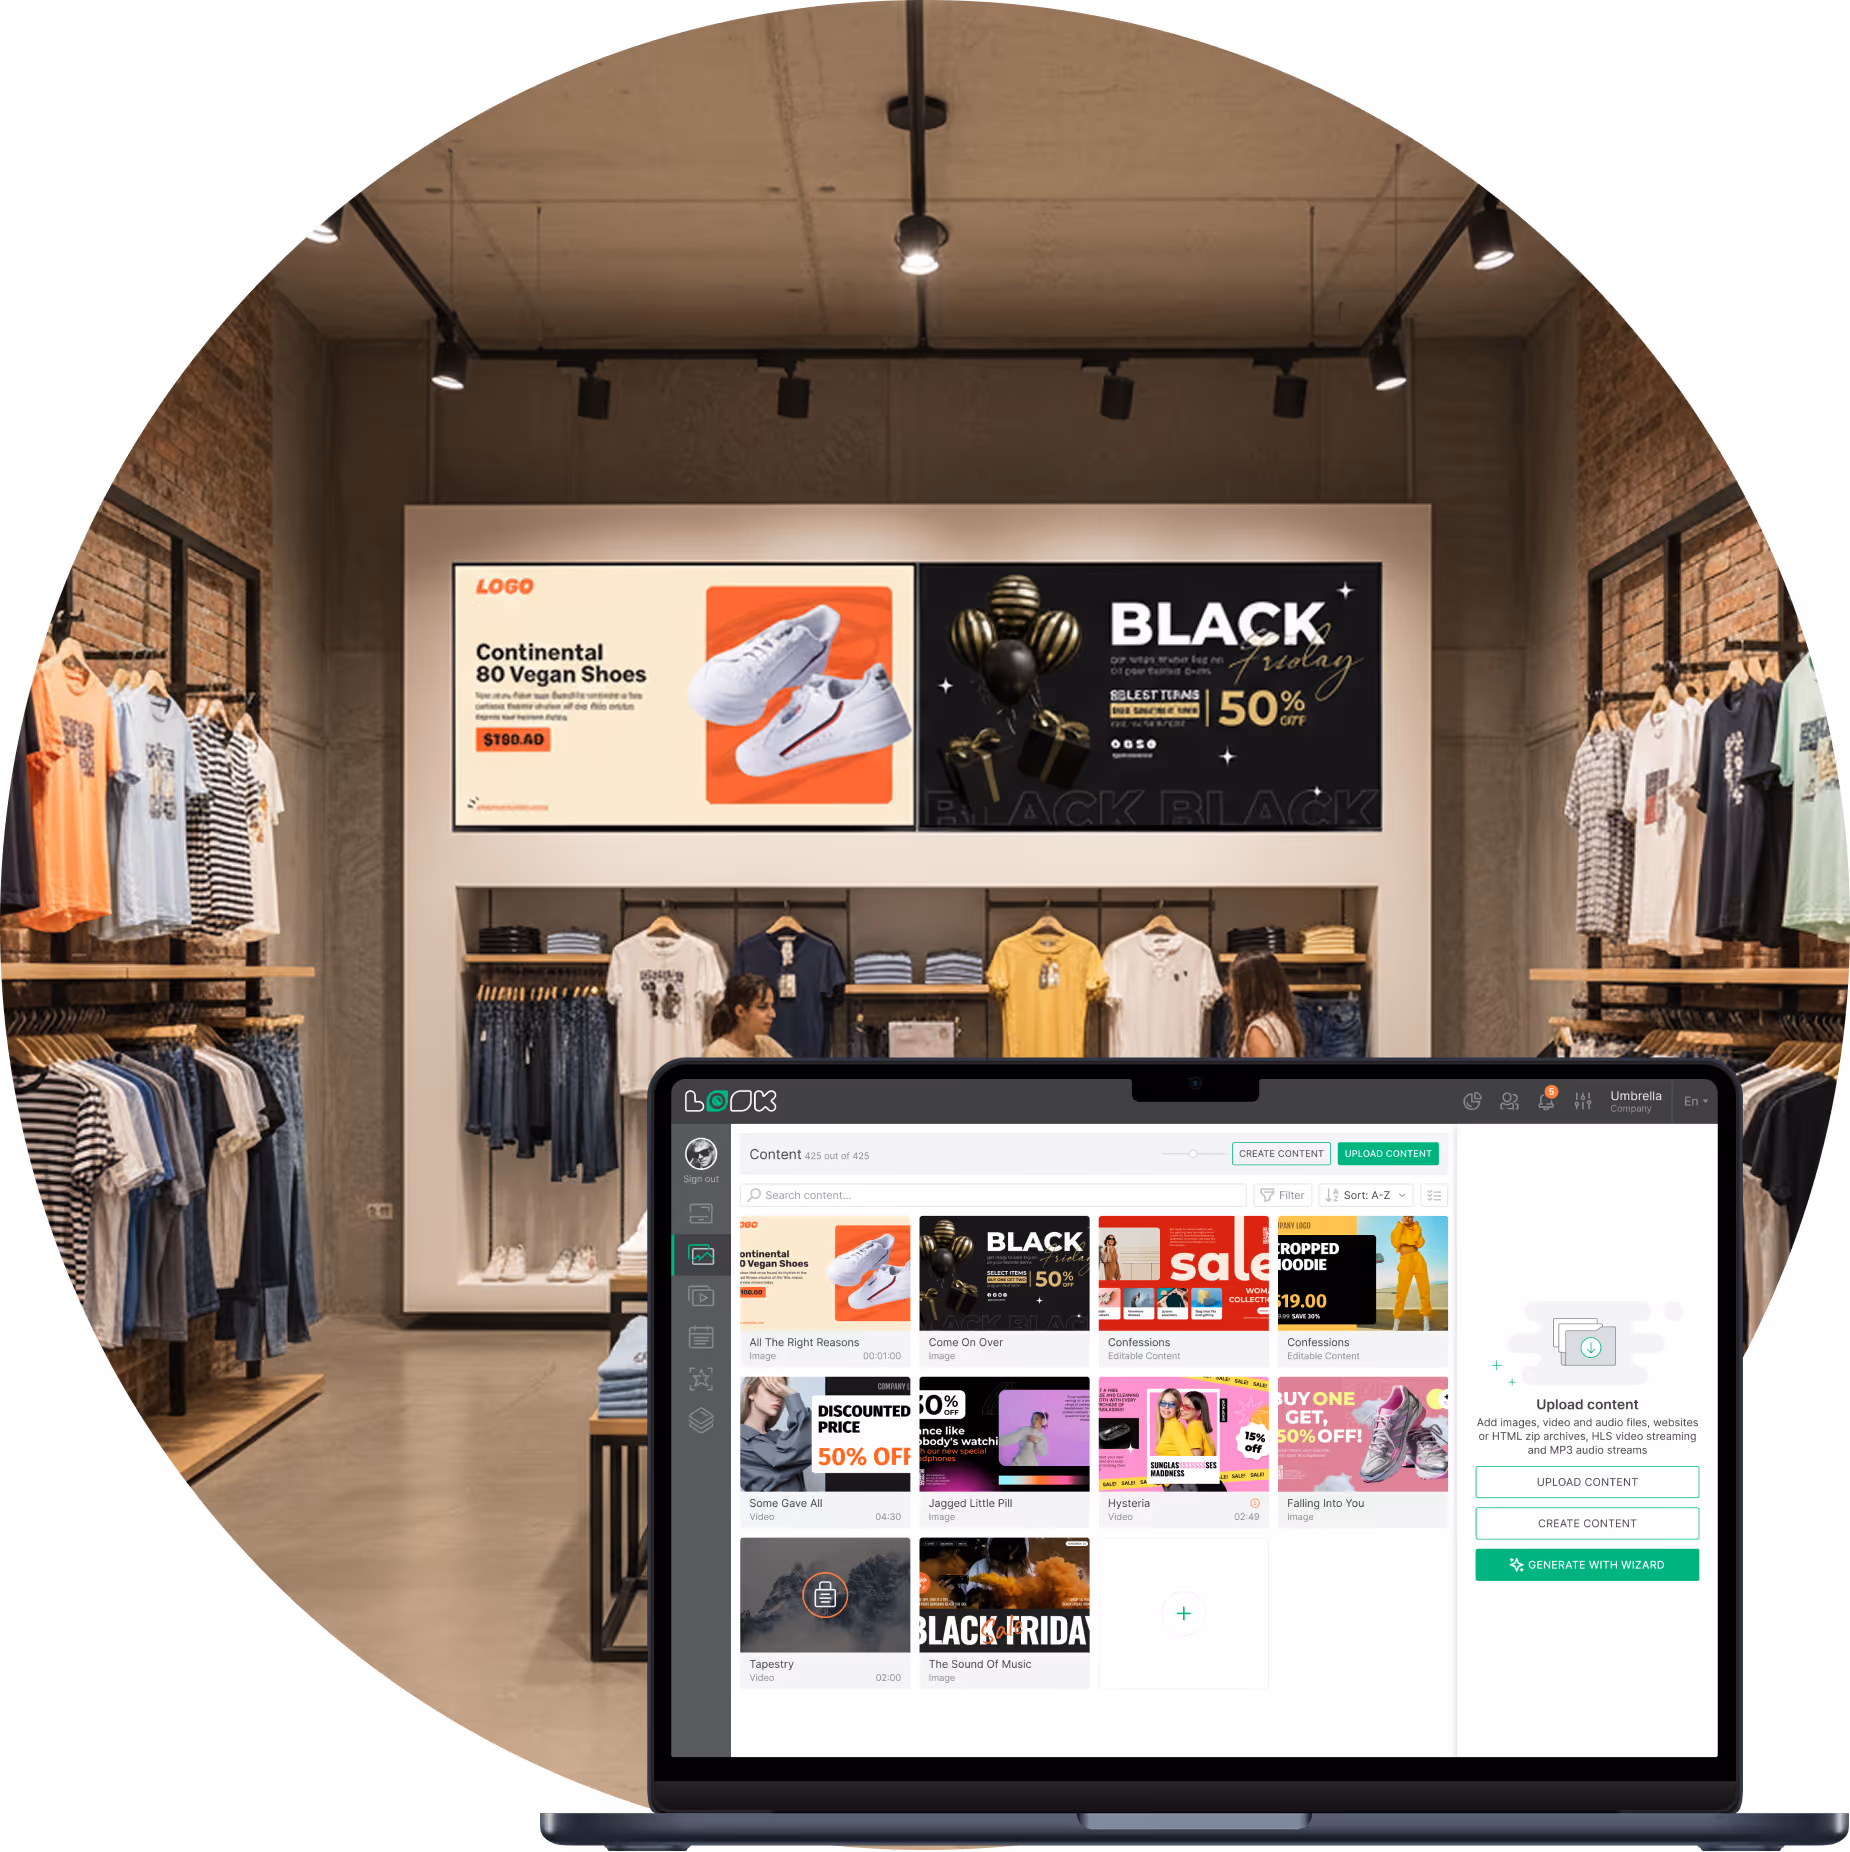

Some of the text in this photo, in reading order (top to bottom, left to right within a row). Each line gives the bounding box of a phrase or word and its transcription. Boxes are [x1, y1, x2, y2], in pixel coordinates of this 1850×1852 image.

[476, 577, 535, 595] LOGO
[1111, 601, 1326, 646] BLACK
[476, 643, 603, 661] Continental
[476, 665, 647, 688] 80 Vegan Shoes
[1548, 1087, 1556, 1096] 5
[1610, 1090, 1662, 1101] Umbrella
[1684, 1096, 1699, 1106] En
[1610, 1104, 1652, 1114] Company
[750, 1149, 870, 1160] Content 425 out of 425
[1239, 1149, 1324, 1158] CREATE CONTENT
[1344, 1149, 1432, 1158] UPLOAD CONTENT
[683, 1174, 720, 1185] Sign out
[765, 1190, 852, 1200] Search content...
[1279, 1189, 1305, 1200] Filter
[1344, 1190, 1390, 1200] Sort: A-Z
[987, 1231, 1084, 1252] BLACK
[748, 1260, 777, 1270] Vegan
[750, 1338, 859, 1349] All The Right Reasons
[929, 1338, 1003, 1346] Come On Over
[1108, 1338, 1170, 1346] Confessions
[1287, 1338, 1350, 1346] Confessions
[750, 1352, 776, 1361] Image
[863, 1352, 901, 1360] 00:01:00
[929, 1352, 955, 1361] Image
[1108, 1352, 1180, 1360] Editable Content
[1287, 1352, 1360, 1360] Editable Content
[1313, 1391, 1355, 1406] ONE
[1536, 1399, 1639, 1411] Upload content
[818, 1405, 910, 1417] DISCOUNTED
[1285, 1410, 1328, 1427] GET,
[1477, 1418, 1699, 1429] Add images, video and audio files, websites
[818, 1421, 860, 1433] PRICE
[945, 1426, 965, 1435] like
[1245, 1431, 1266, 1443] 15%
[1317, 1429, 1362, 1443] OFF!
[1492, 1432, 1522, 1441] HTML
[1525, 1432, 1540, 1443] zip
[1543, 1432, 1589, 1443] archives,
[1592, 1432, 1613, 1441] HLS
[1616, 1432, 1643, 1441] video
[1647, 1432, 1697, 1443] streaming
[960, 1448, 987, 1456] special
[1245, 1444, 1263, 1454] off
[1528, 1446, 1647, 1455] and MP3 audio streams
[818, 1447, 867, 1466] 50%
[1537, 1478, 1638, 1487] UPLOAD CONTENT
[750, 1499, 823, 1507] Some Gave All
[929, 1499, 1013, 1510] Jagged Little Pill
[1108, 1499, 1150, 1510] Hysteria
[1287, 1499, 1365, 1510] Falling Into You
[750, 1513, 775, 1521] Video
[875, 1513, 901, 1521] 04:30
[929, 1513, 955, 1522] Image
[1108, 1513, 1133, 1521] Video
[1234, 1513, 1260, 1521] 02:49
[1287, 1513, 1314, 1522] Image
[1538, 1519, 1637, 1528] CREATE CONTENT
[1528, 1560, 1665, 1570] GENERATE WITH WIZARD
[981, 1615, 1023, 1645] Sale
[750, 1660, 794, 1670] Tapestry
[929, 1660, 1032, 1669] The Sound Of Music
[750, 1674, 775, 1682] Video
[875, 1674, 902, 1682] 02:00
[929, 1674, 956, 1683] Image
